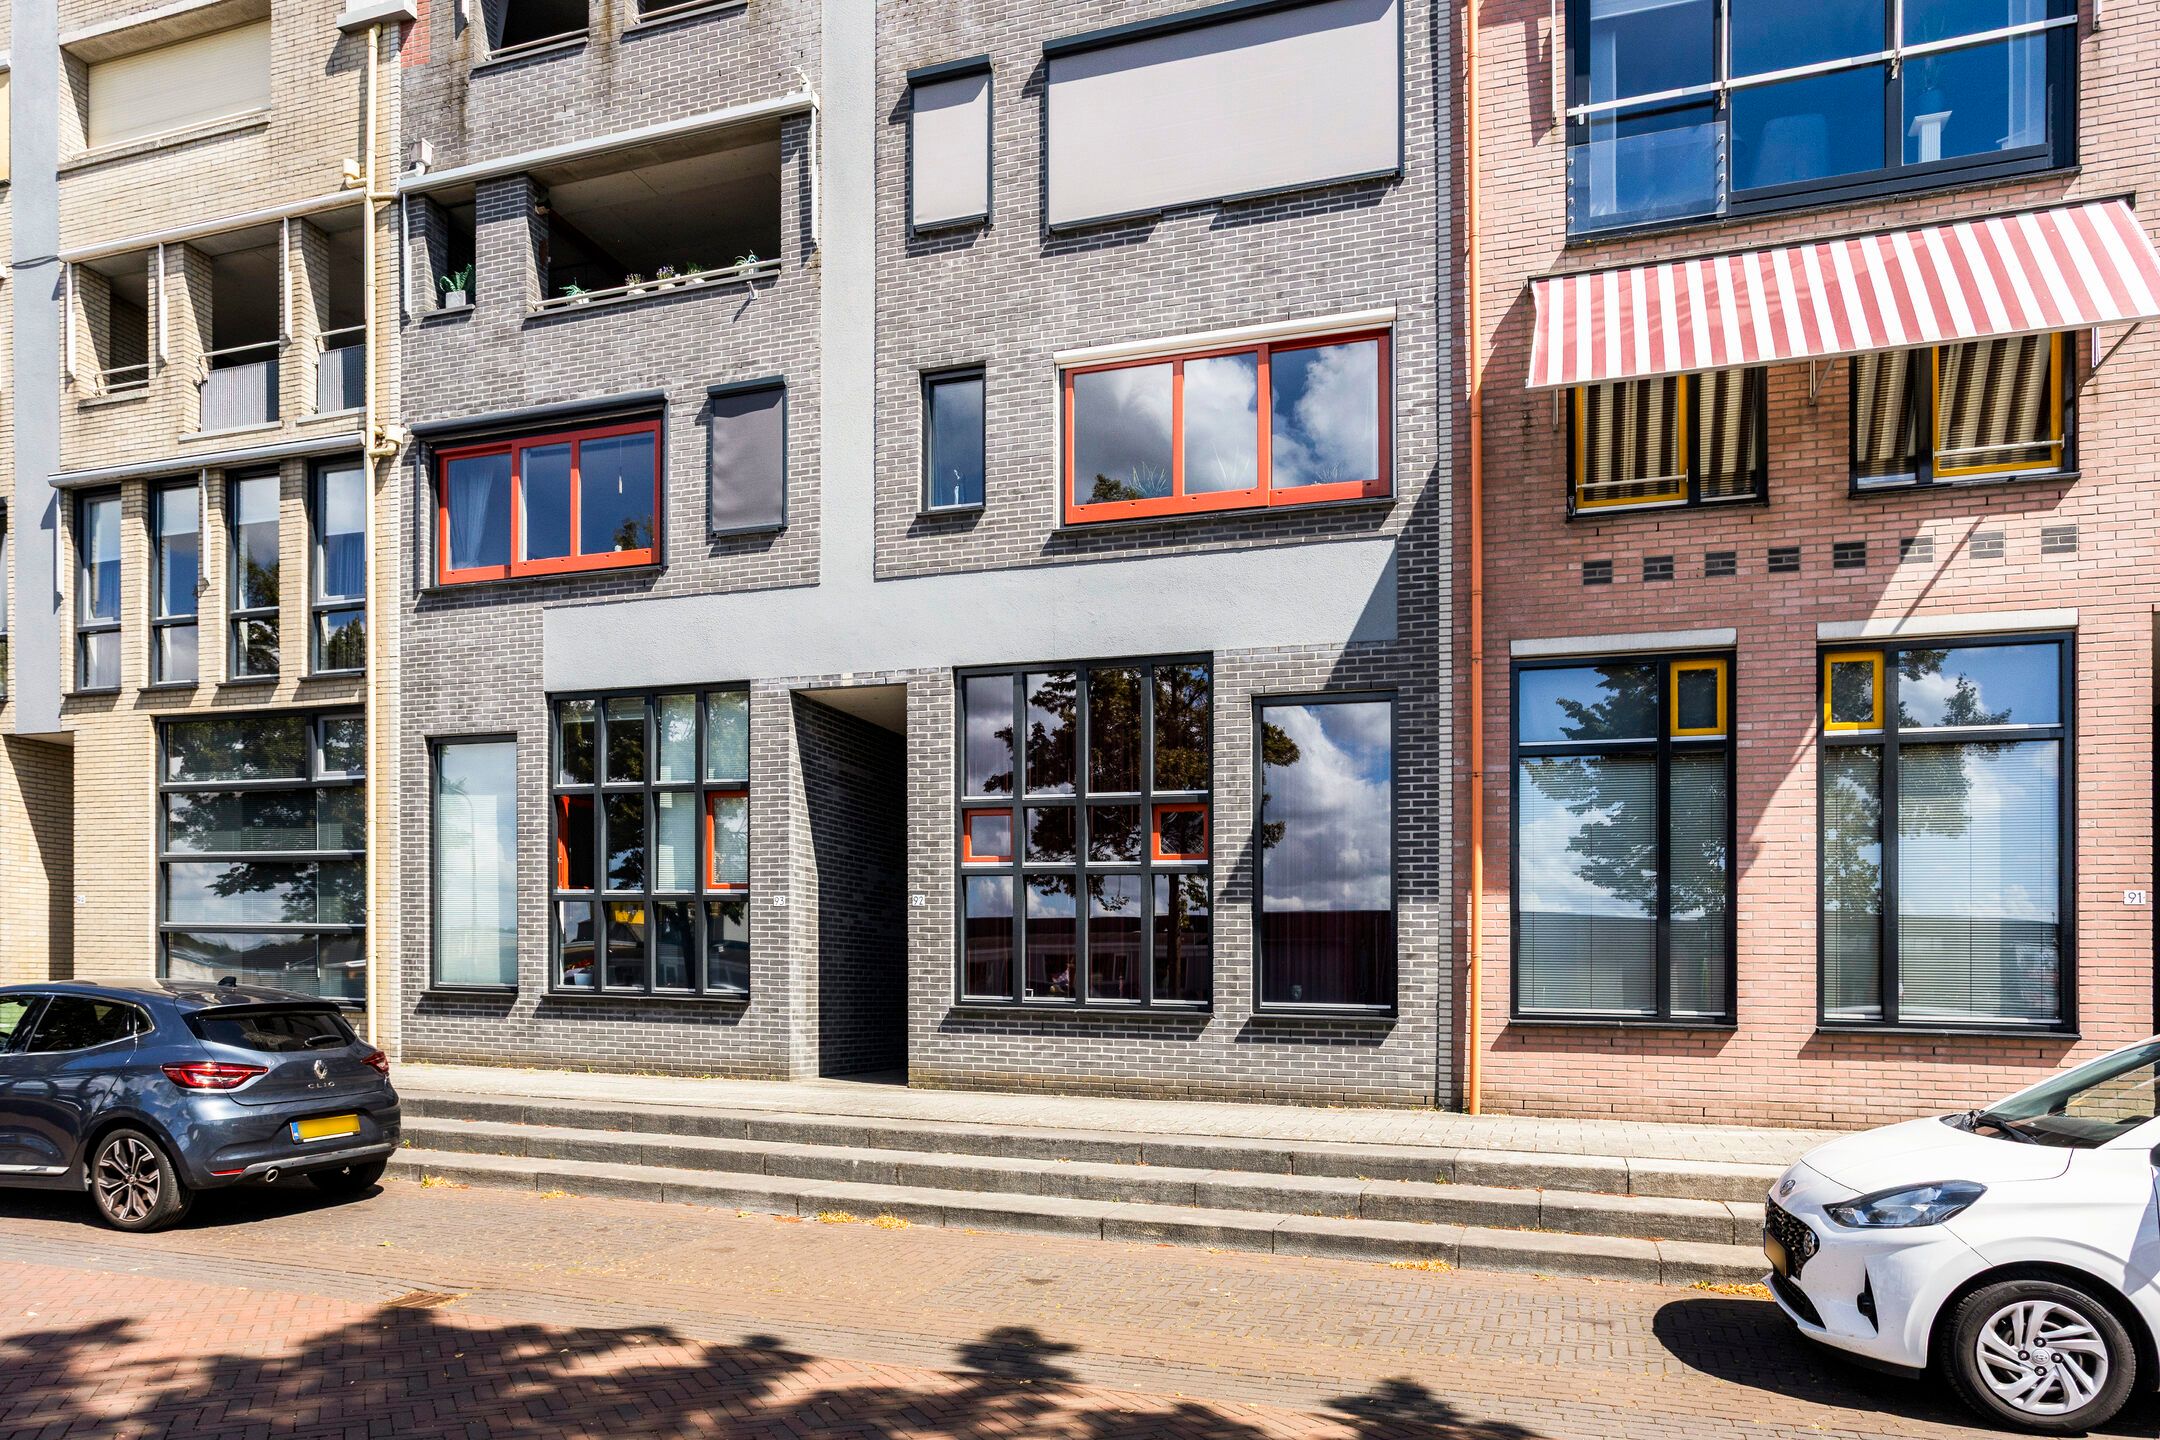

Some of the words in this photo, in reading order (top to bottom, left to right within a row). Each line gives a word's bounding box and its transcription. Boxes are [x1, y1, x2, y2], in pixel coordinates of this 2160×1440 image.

[774, 896, 785, 905] 93
[913, 895, 924, 905] 92
[2128, 891, 2142, 903] 91
[307, 1081, 336, 1089] CLIO
